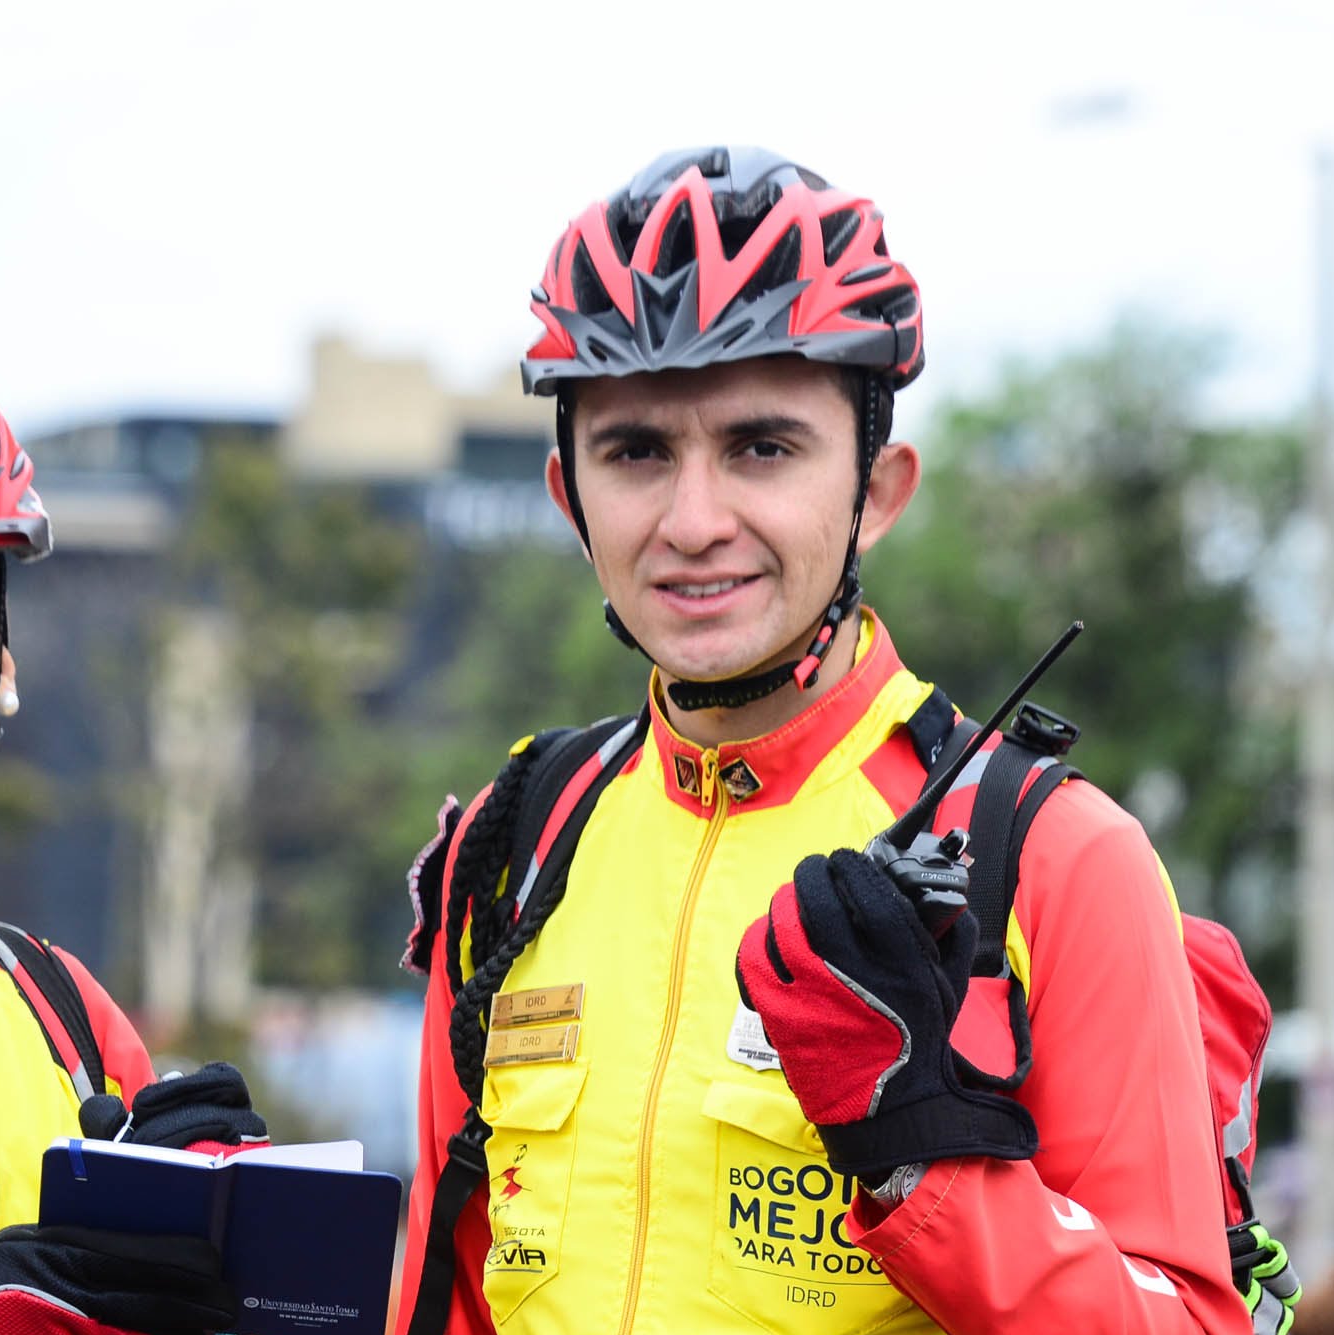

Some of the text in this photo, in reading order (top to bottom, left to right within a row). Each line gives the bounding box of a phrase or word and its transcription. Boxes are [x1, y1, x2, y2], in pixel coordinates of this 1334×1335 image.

[525, 996, 547, 1008] IDRD
[519, 1036, 541, 1048] IDRD
[786, 1285, 836, 1308] IDRD
